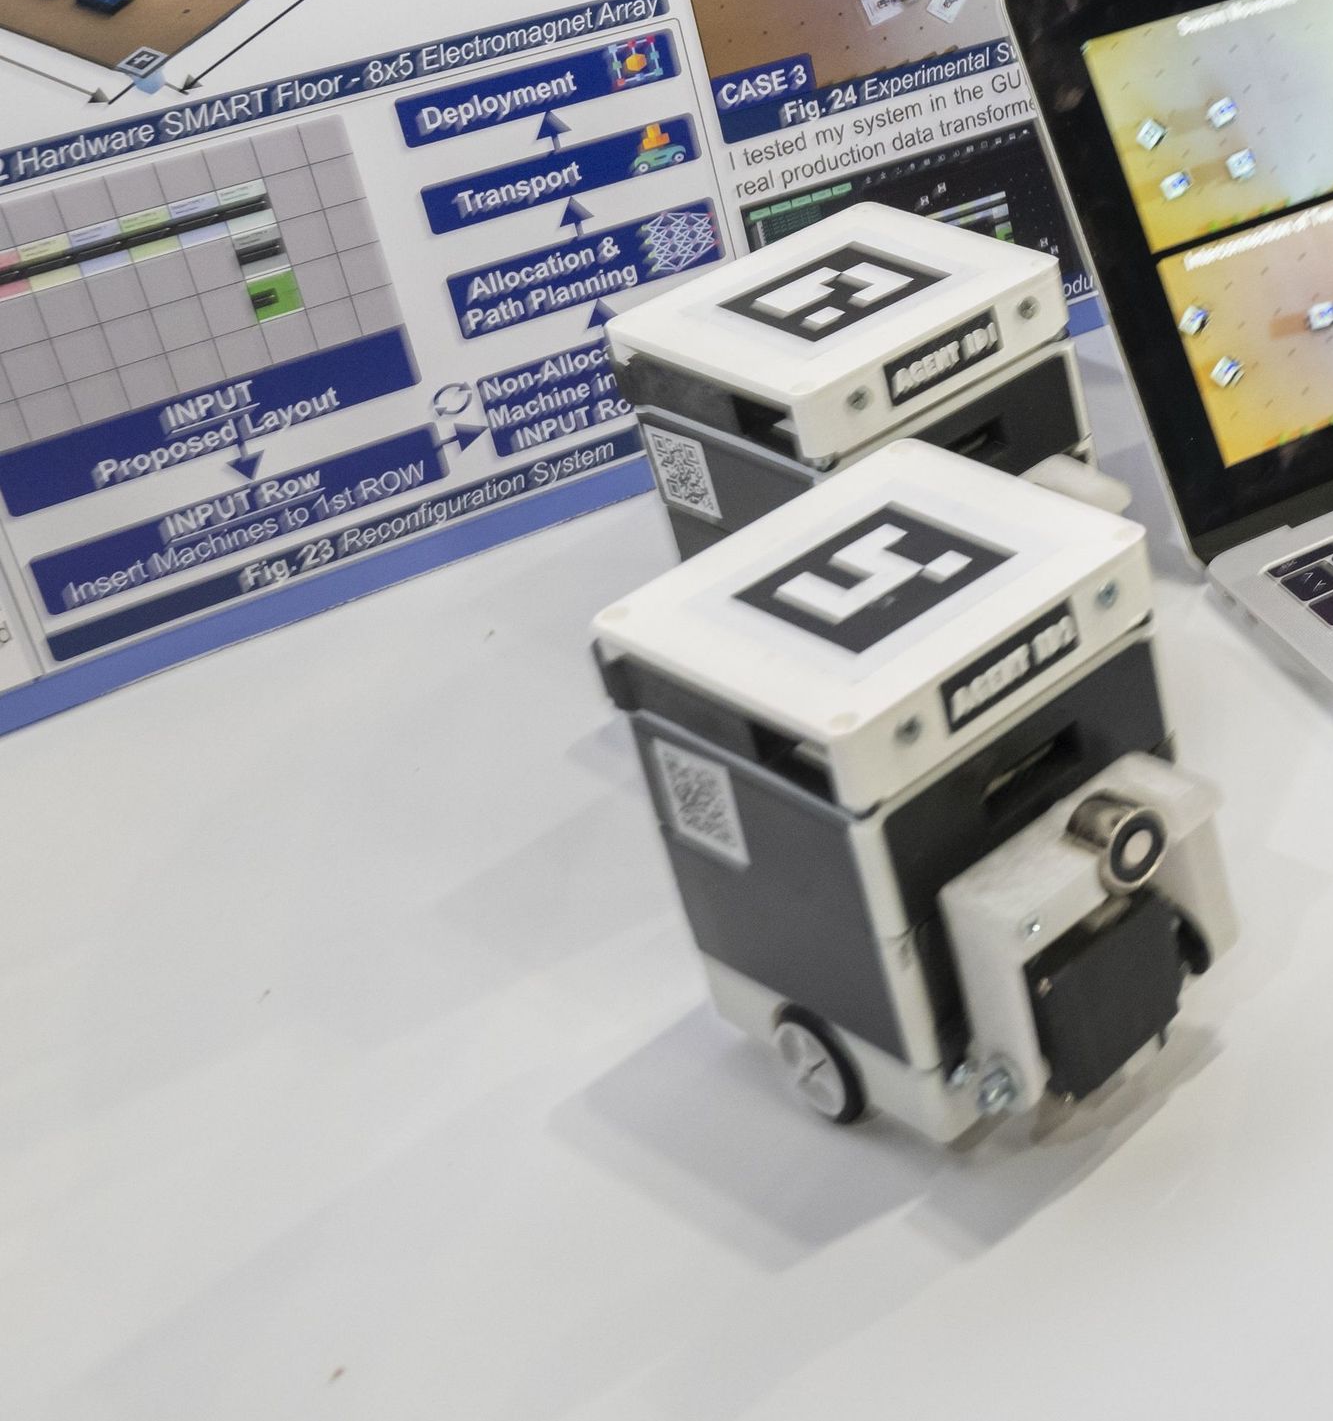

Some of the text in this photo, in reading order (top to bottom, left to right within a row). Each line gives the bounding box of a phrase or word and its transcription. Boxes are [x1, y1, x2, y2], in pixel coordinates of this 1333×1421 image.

[17, 117, 157, 177] Hardware
[164, 89, 268, 137] SMART
[275, 70, 344, 110] Floor
[368, 53, 415, 87] 8x5
[421, 7, 594, 73] Electromagnet
[420, 69, 578, 131] Deployment
[721, 65, 807, 105] CASE 3
[783, 47, 991, 124] Fig. 24 Experimental
[457, 162, 583, 216] Transport
[467, 262, 638, 333] Path Planning
[468, 236, 621, 300] Allocation &
[97, 385, 340, 482] Proposed Layout
[163, 381, 253, 429] INPUT
[162, 468, 321, 540] INPUT Row
[243, 439, 615, 592] Fig. 23 Reconfiguration System
